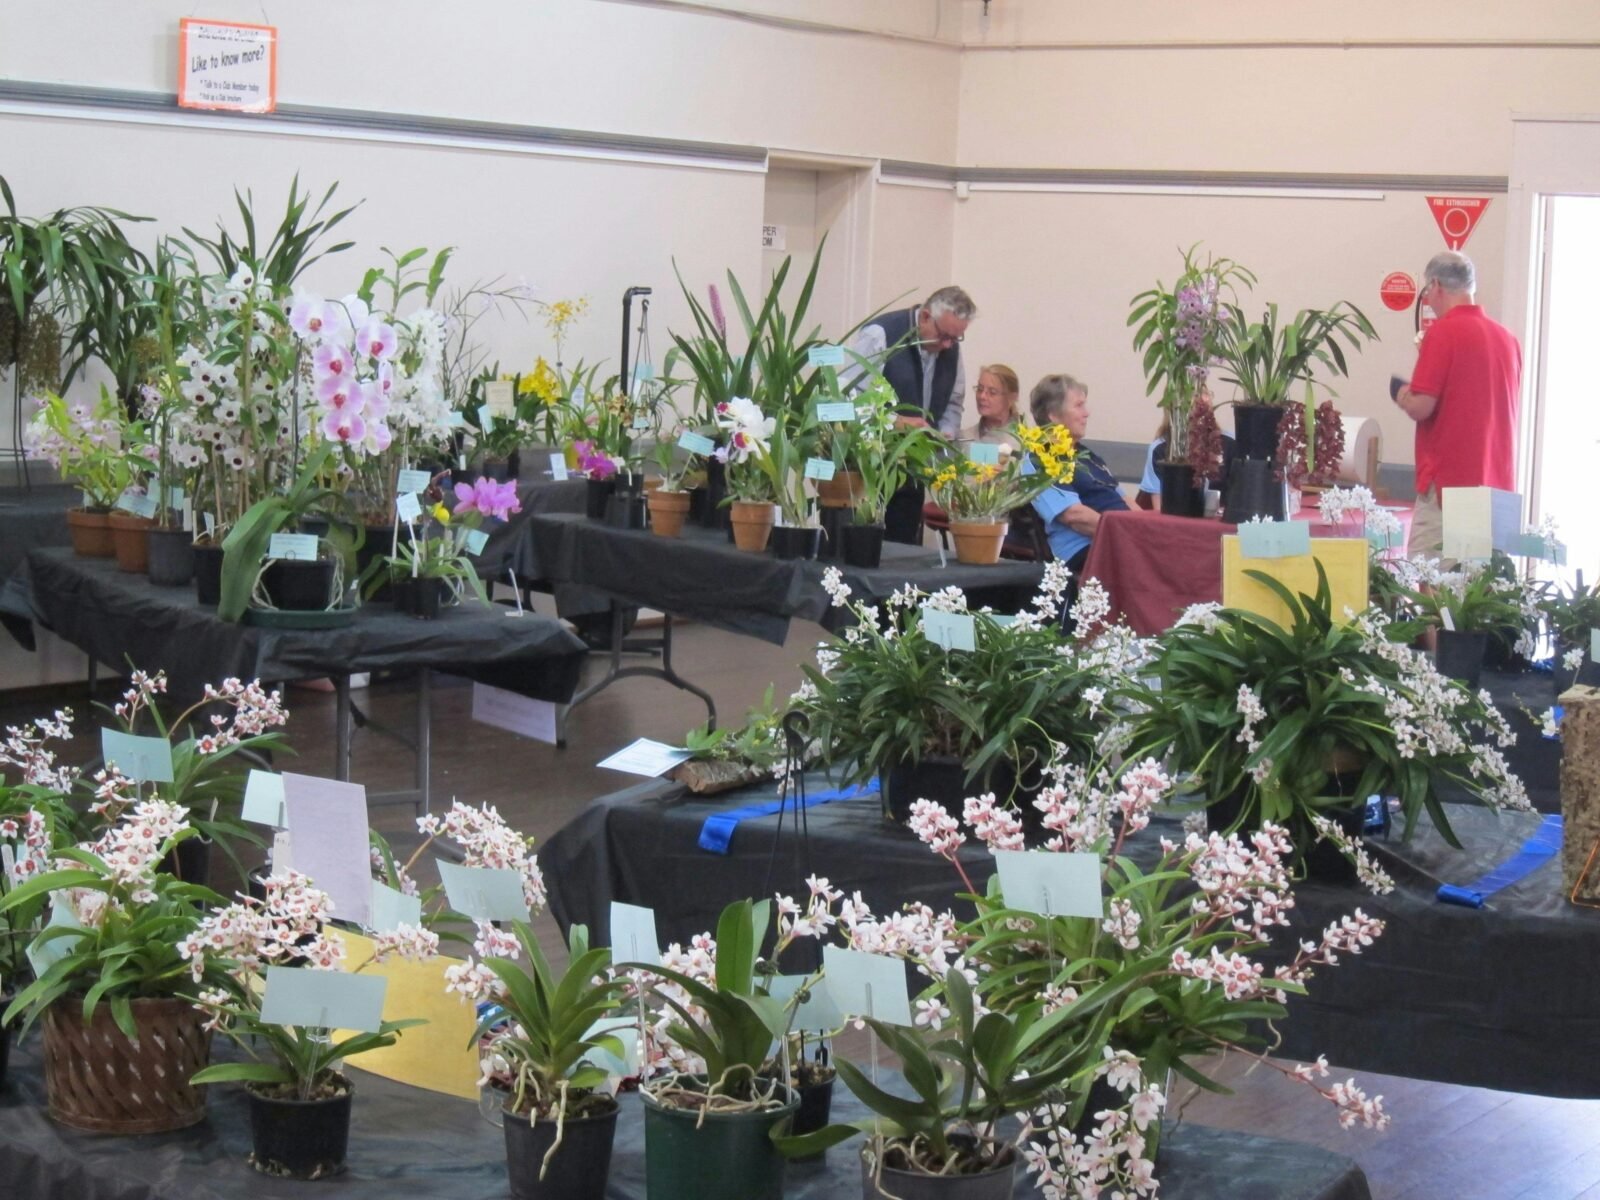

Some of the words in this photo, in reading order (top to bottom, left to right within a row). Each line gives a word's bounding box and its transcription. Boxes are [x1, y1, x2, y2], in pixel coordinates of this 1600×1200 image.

[192, 55, 207, 73] Like
[210, 54, 218, 69] to
[221, 50, 239, 67] know
[242, 44, 265, 63] more?
[1433, 198, 1444, 206] FIRE
[763, 225, 776, 236] PER
